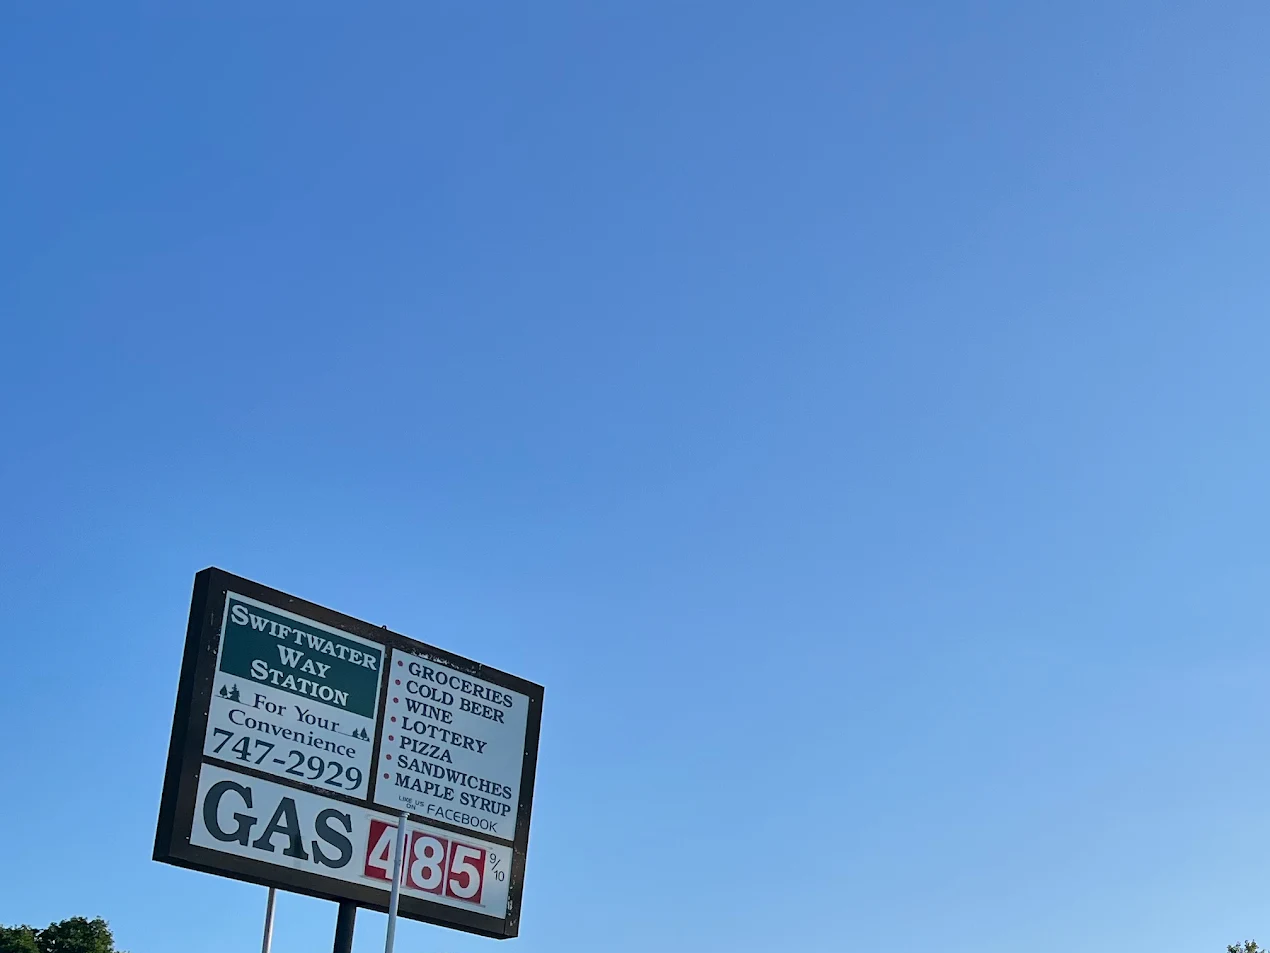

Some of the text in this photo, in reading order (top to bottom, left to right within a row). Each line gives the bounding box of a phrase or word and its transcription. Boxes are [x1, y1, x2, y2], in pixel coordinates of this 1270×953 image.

[231, 605, 377, 670] SWIFTWATER
[277, 644, 331, 678] WAY
[250, 660, 349, 706] STATION
[406, 681, 505, 724] COLD BEER
[408, 662, 513, 708] GROCERIES
[253, 693, 340, 733] For Your
[405, 698, 453, 724] WINE
[228, 709, 356, 758] Convenience
[399, 736, 453, 763] PIZZA
[401, 716, 487, 754] LOTTERY
[213, 728, 362, 791] 747-2929
[397, 755, 512, 799] SANDWICHES
[394, 773, 511, 817] MAPLE SYRUP
[399, 795, 412, 803] LIKE
[406, 803, 416, 811] ON
[203, 780, 353, 869] GAS
[427, 804, 498, 833] FACEBOOK
